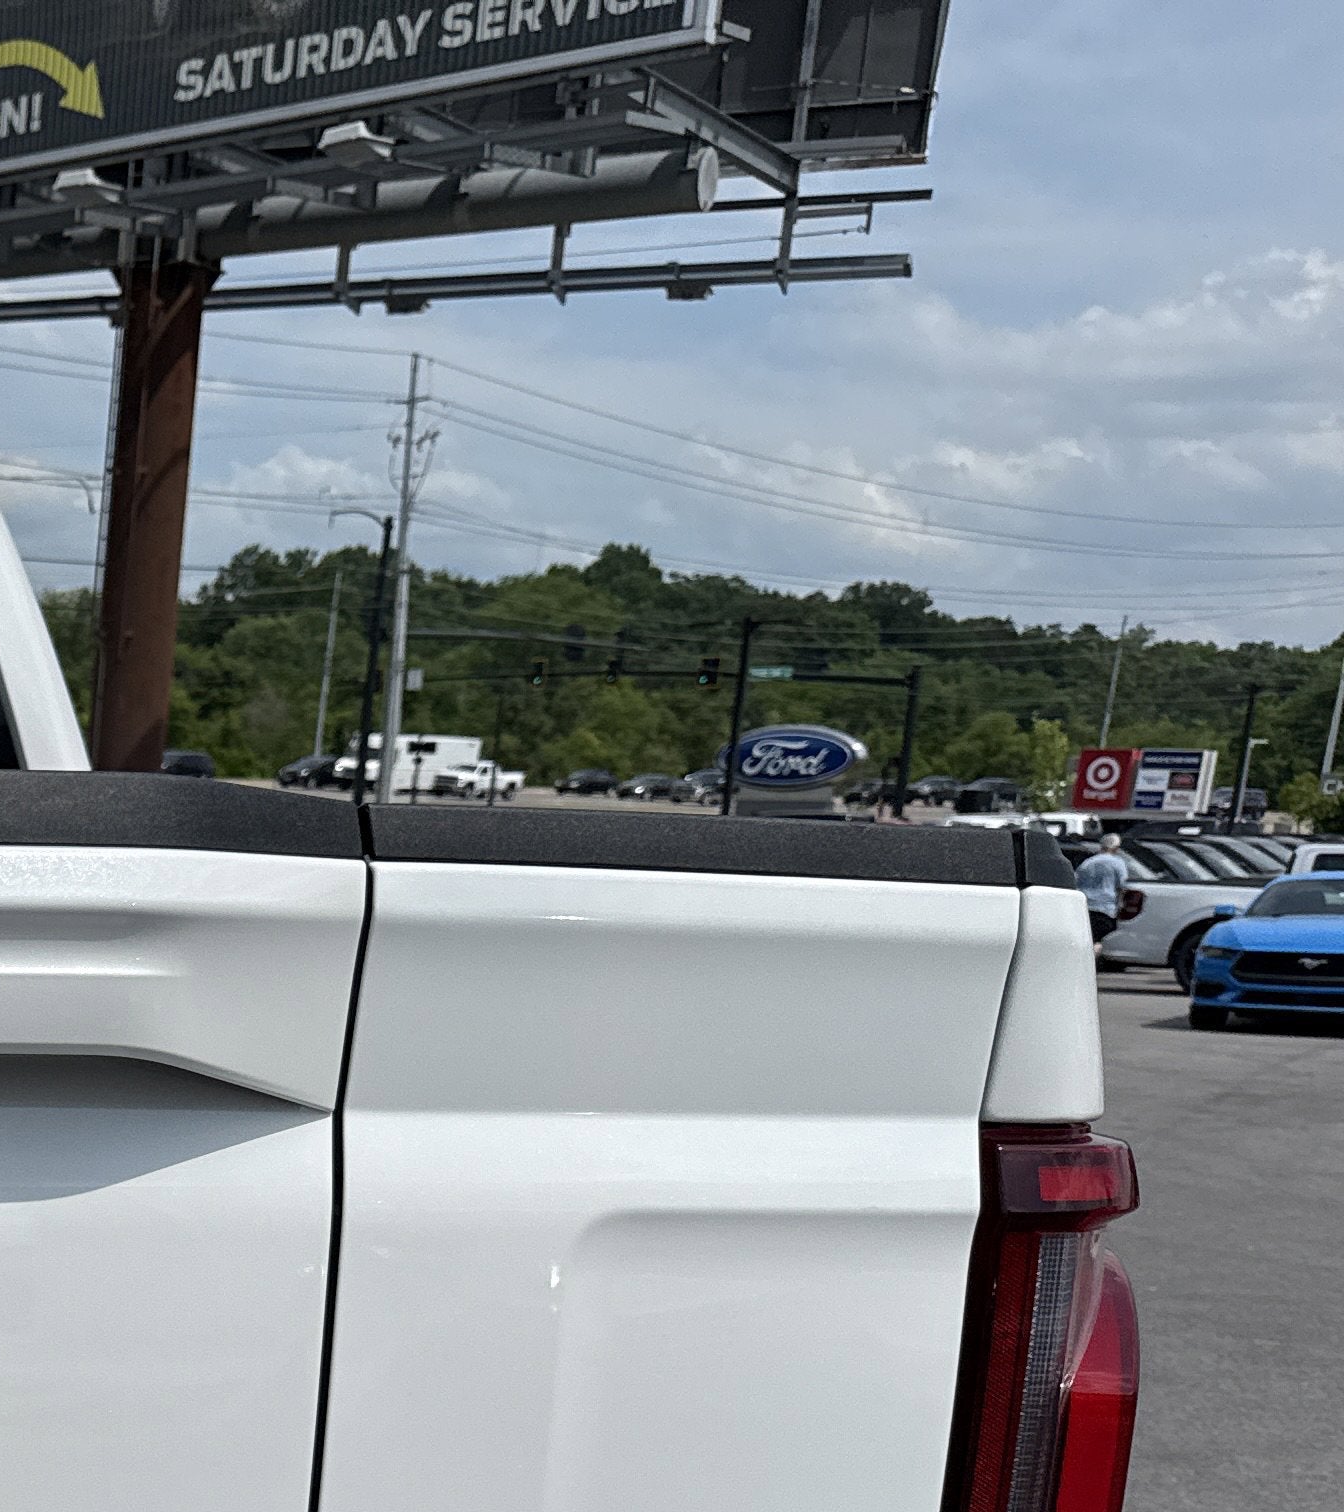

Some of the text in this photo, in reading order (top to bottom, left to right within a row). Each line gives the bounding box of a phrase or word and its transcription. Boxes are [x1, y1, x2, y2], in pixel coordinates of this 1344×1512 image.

[173, 0, 677, 101] SATURDAY SERV
[742, 739, 830, 776] Ford
